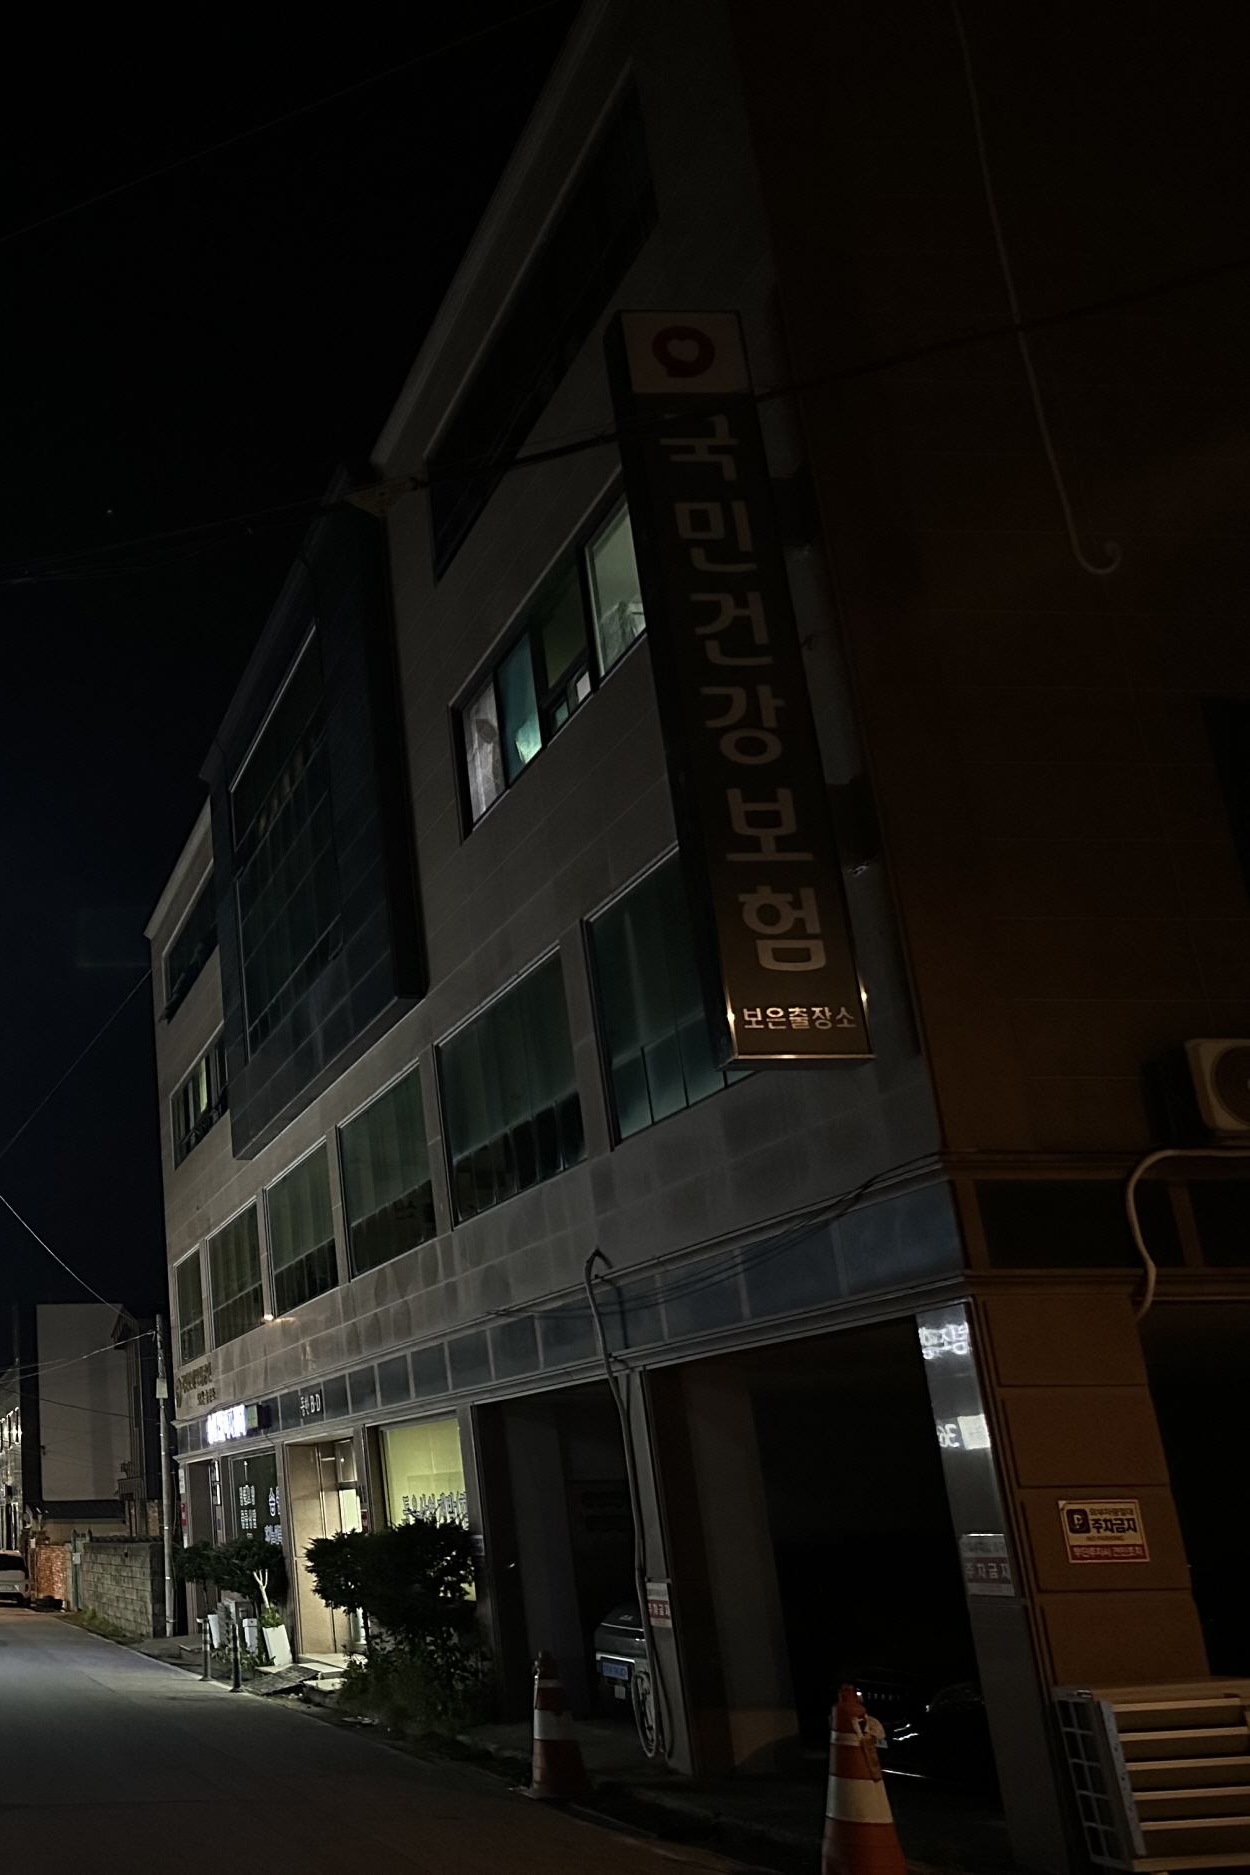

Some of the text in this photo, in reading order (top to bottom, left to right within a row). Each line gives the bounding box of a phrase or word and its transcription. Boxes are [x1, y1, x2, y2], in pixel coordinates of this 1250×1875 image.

[659, 413, 828, 973] 국민건강보험
[742, 1007, 857, 1032] 보은출장소
[1091, 1517, 1138, 1534] 주차금지
[965, 1562, 1011, 1580] 주차금지
